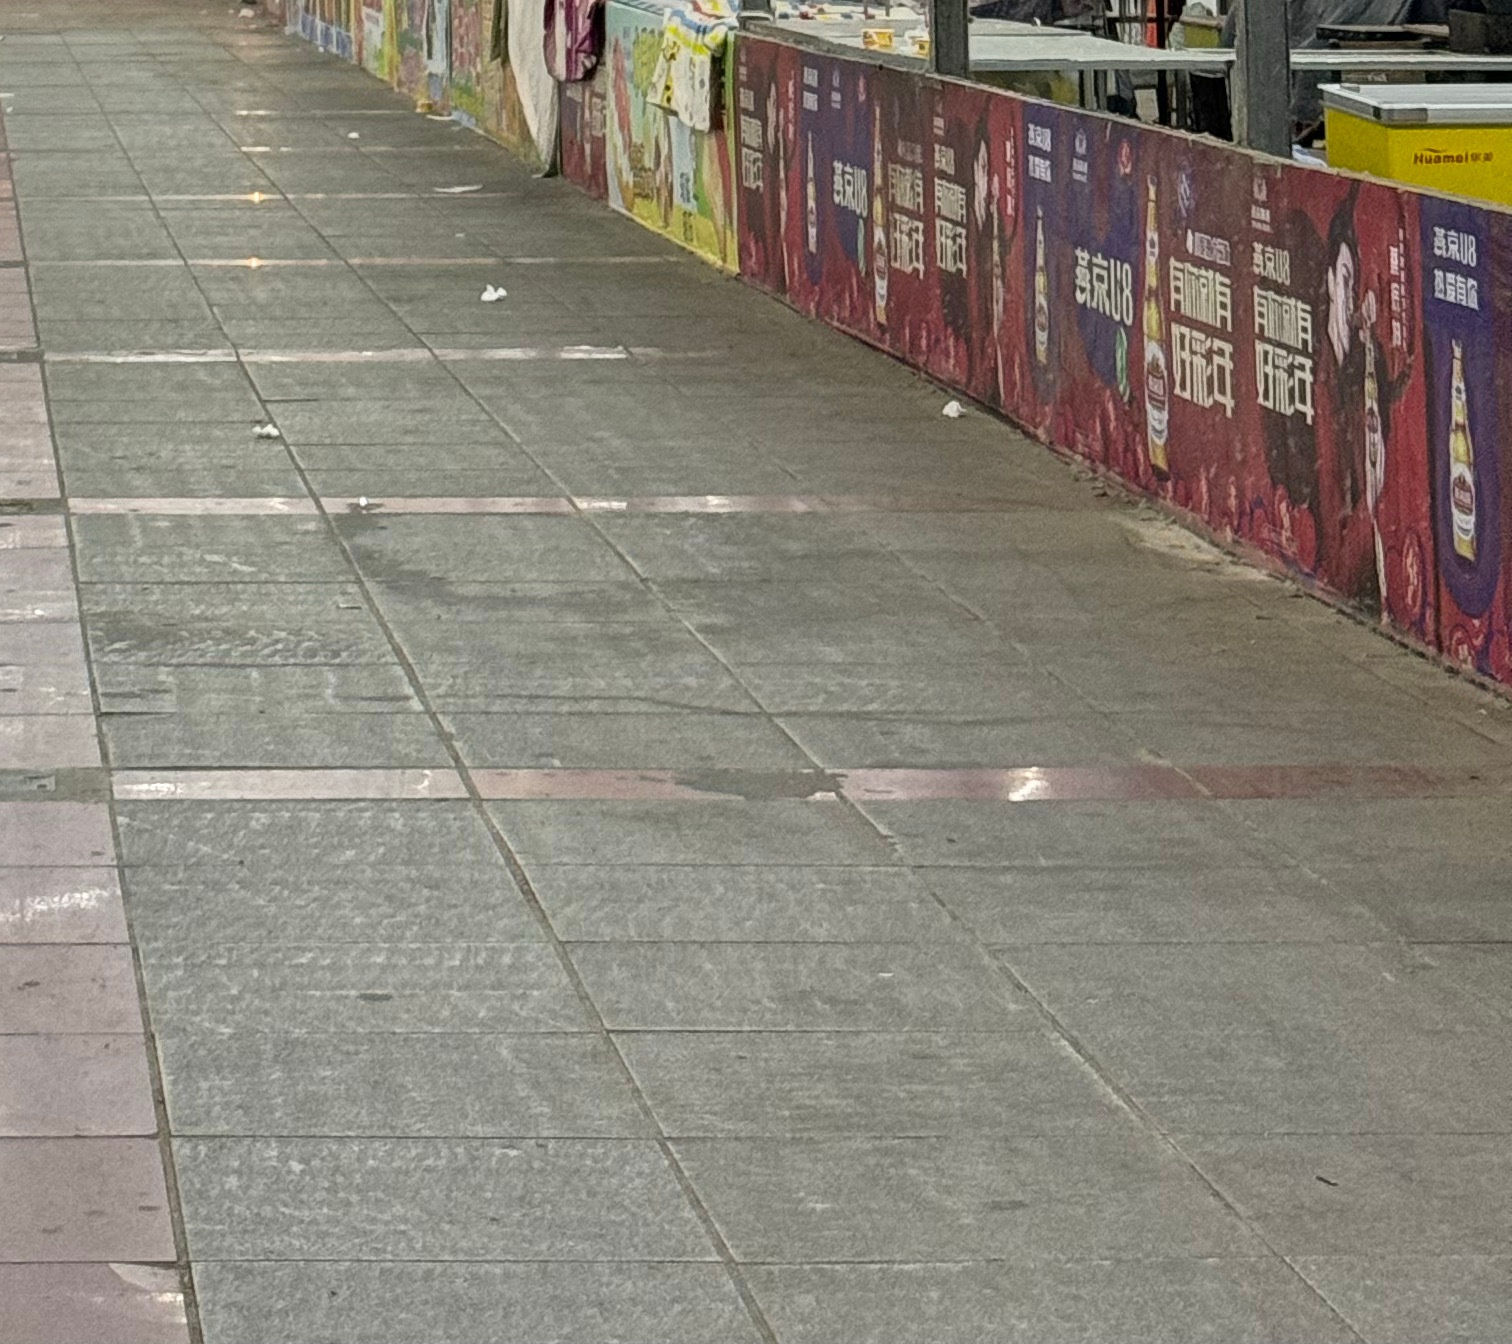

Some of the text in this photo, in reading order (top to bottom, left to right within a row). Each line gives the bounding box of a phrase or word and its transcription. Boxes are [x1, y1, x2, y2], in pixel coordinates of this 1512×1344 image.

[833, 160, 868, 218] 燕京U8
[1252, 241, 1292, 286] 燕京U8
[1433, 226, 1477, 268] 燕京U8
[1074, 246, 1134, 327] 燕京U8
